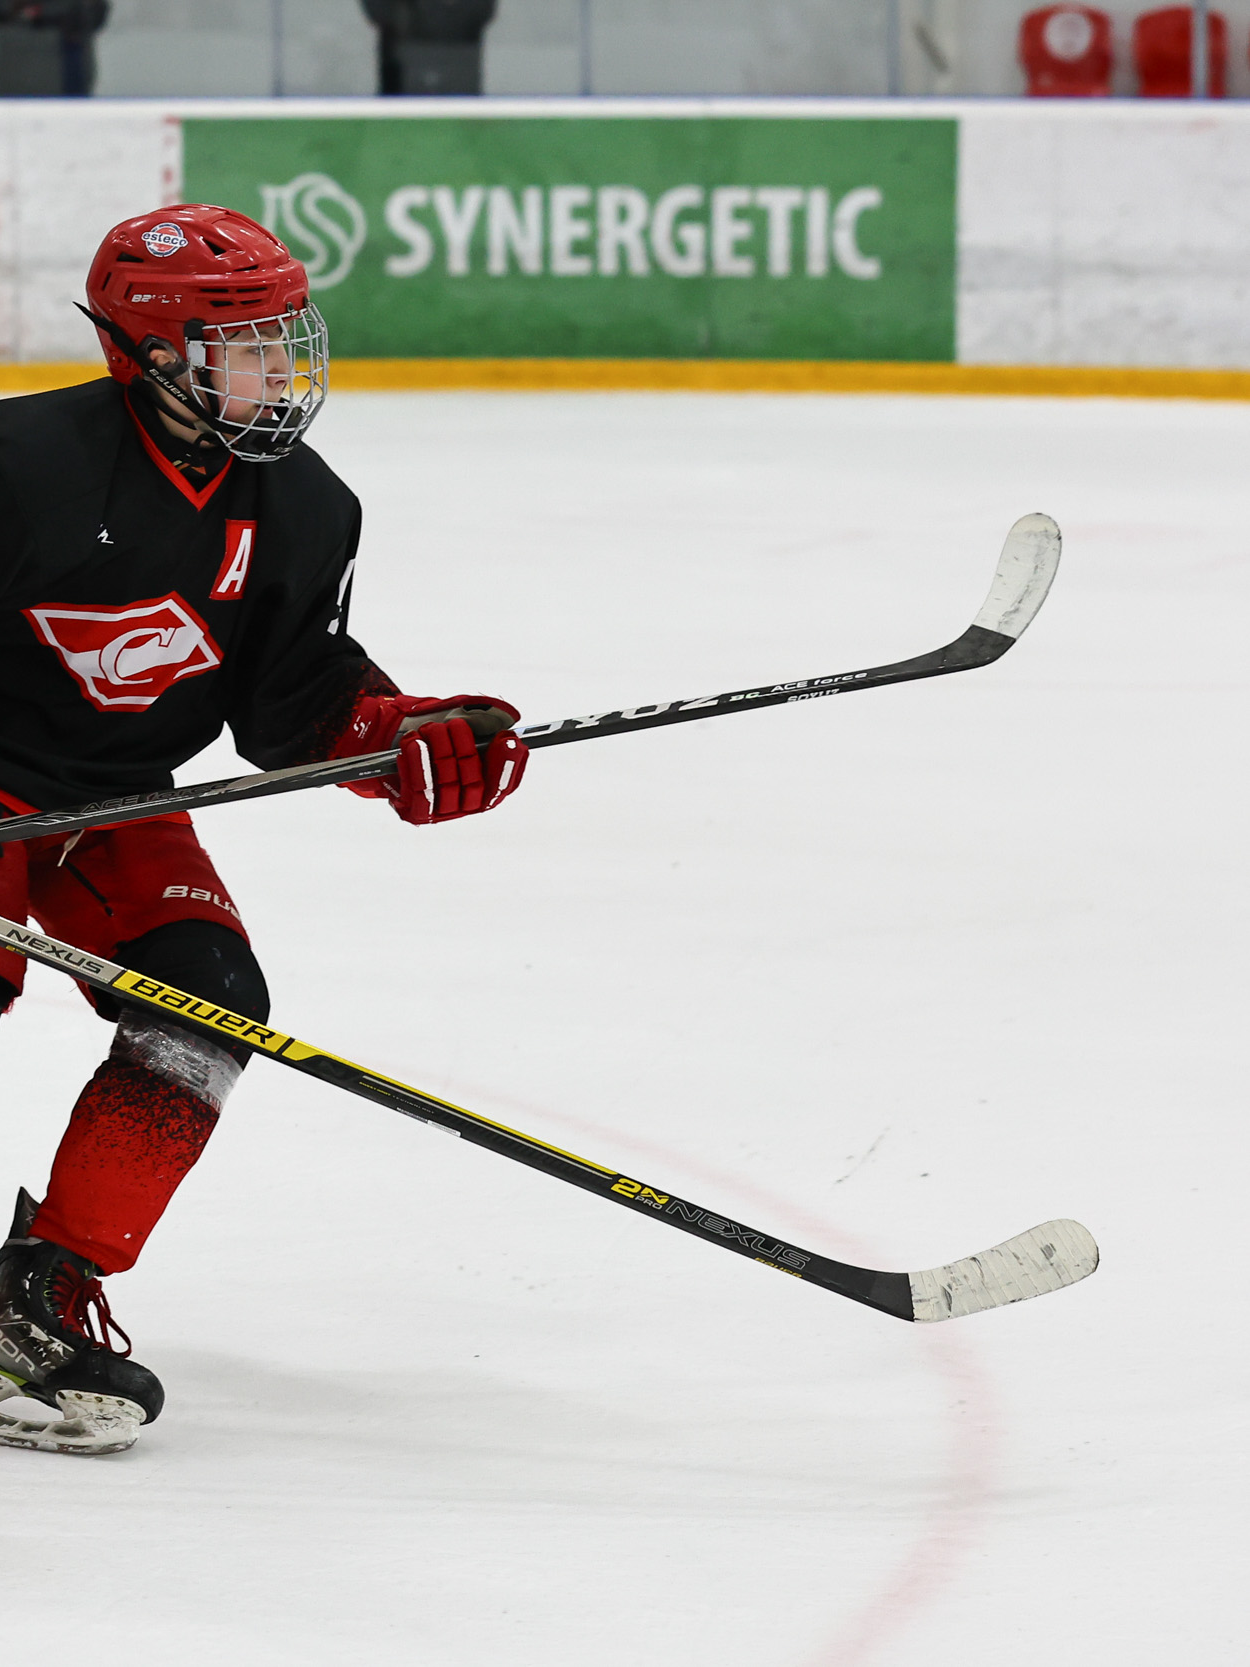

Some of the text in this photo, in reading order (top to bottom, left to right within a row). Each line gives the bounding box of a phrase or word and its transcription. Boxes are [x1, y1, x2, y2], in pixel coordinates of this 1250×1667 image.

[142, 232, 188, 247] esteco
[384, 183, 884, 281] SYNERGETIC
[216, 528, 253, 594] A
[771, 672, 868, 693] ACE force
[512, 693, 725, 738] OYUZ
[6, 928, 276, 1046] NEXUS BAUER
[635, 1195, 663, 1210] PRO
[666, 1200, 811, 1270] NEXUS
